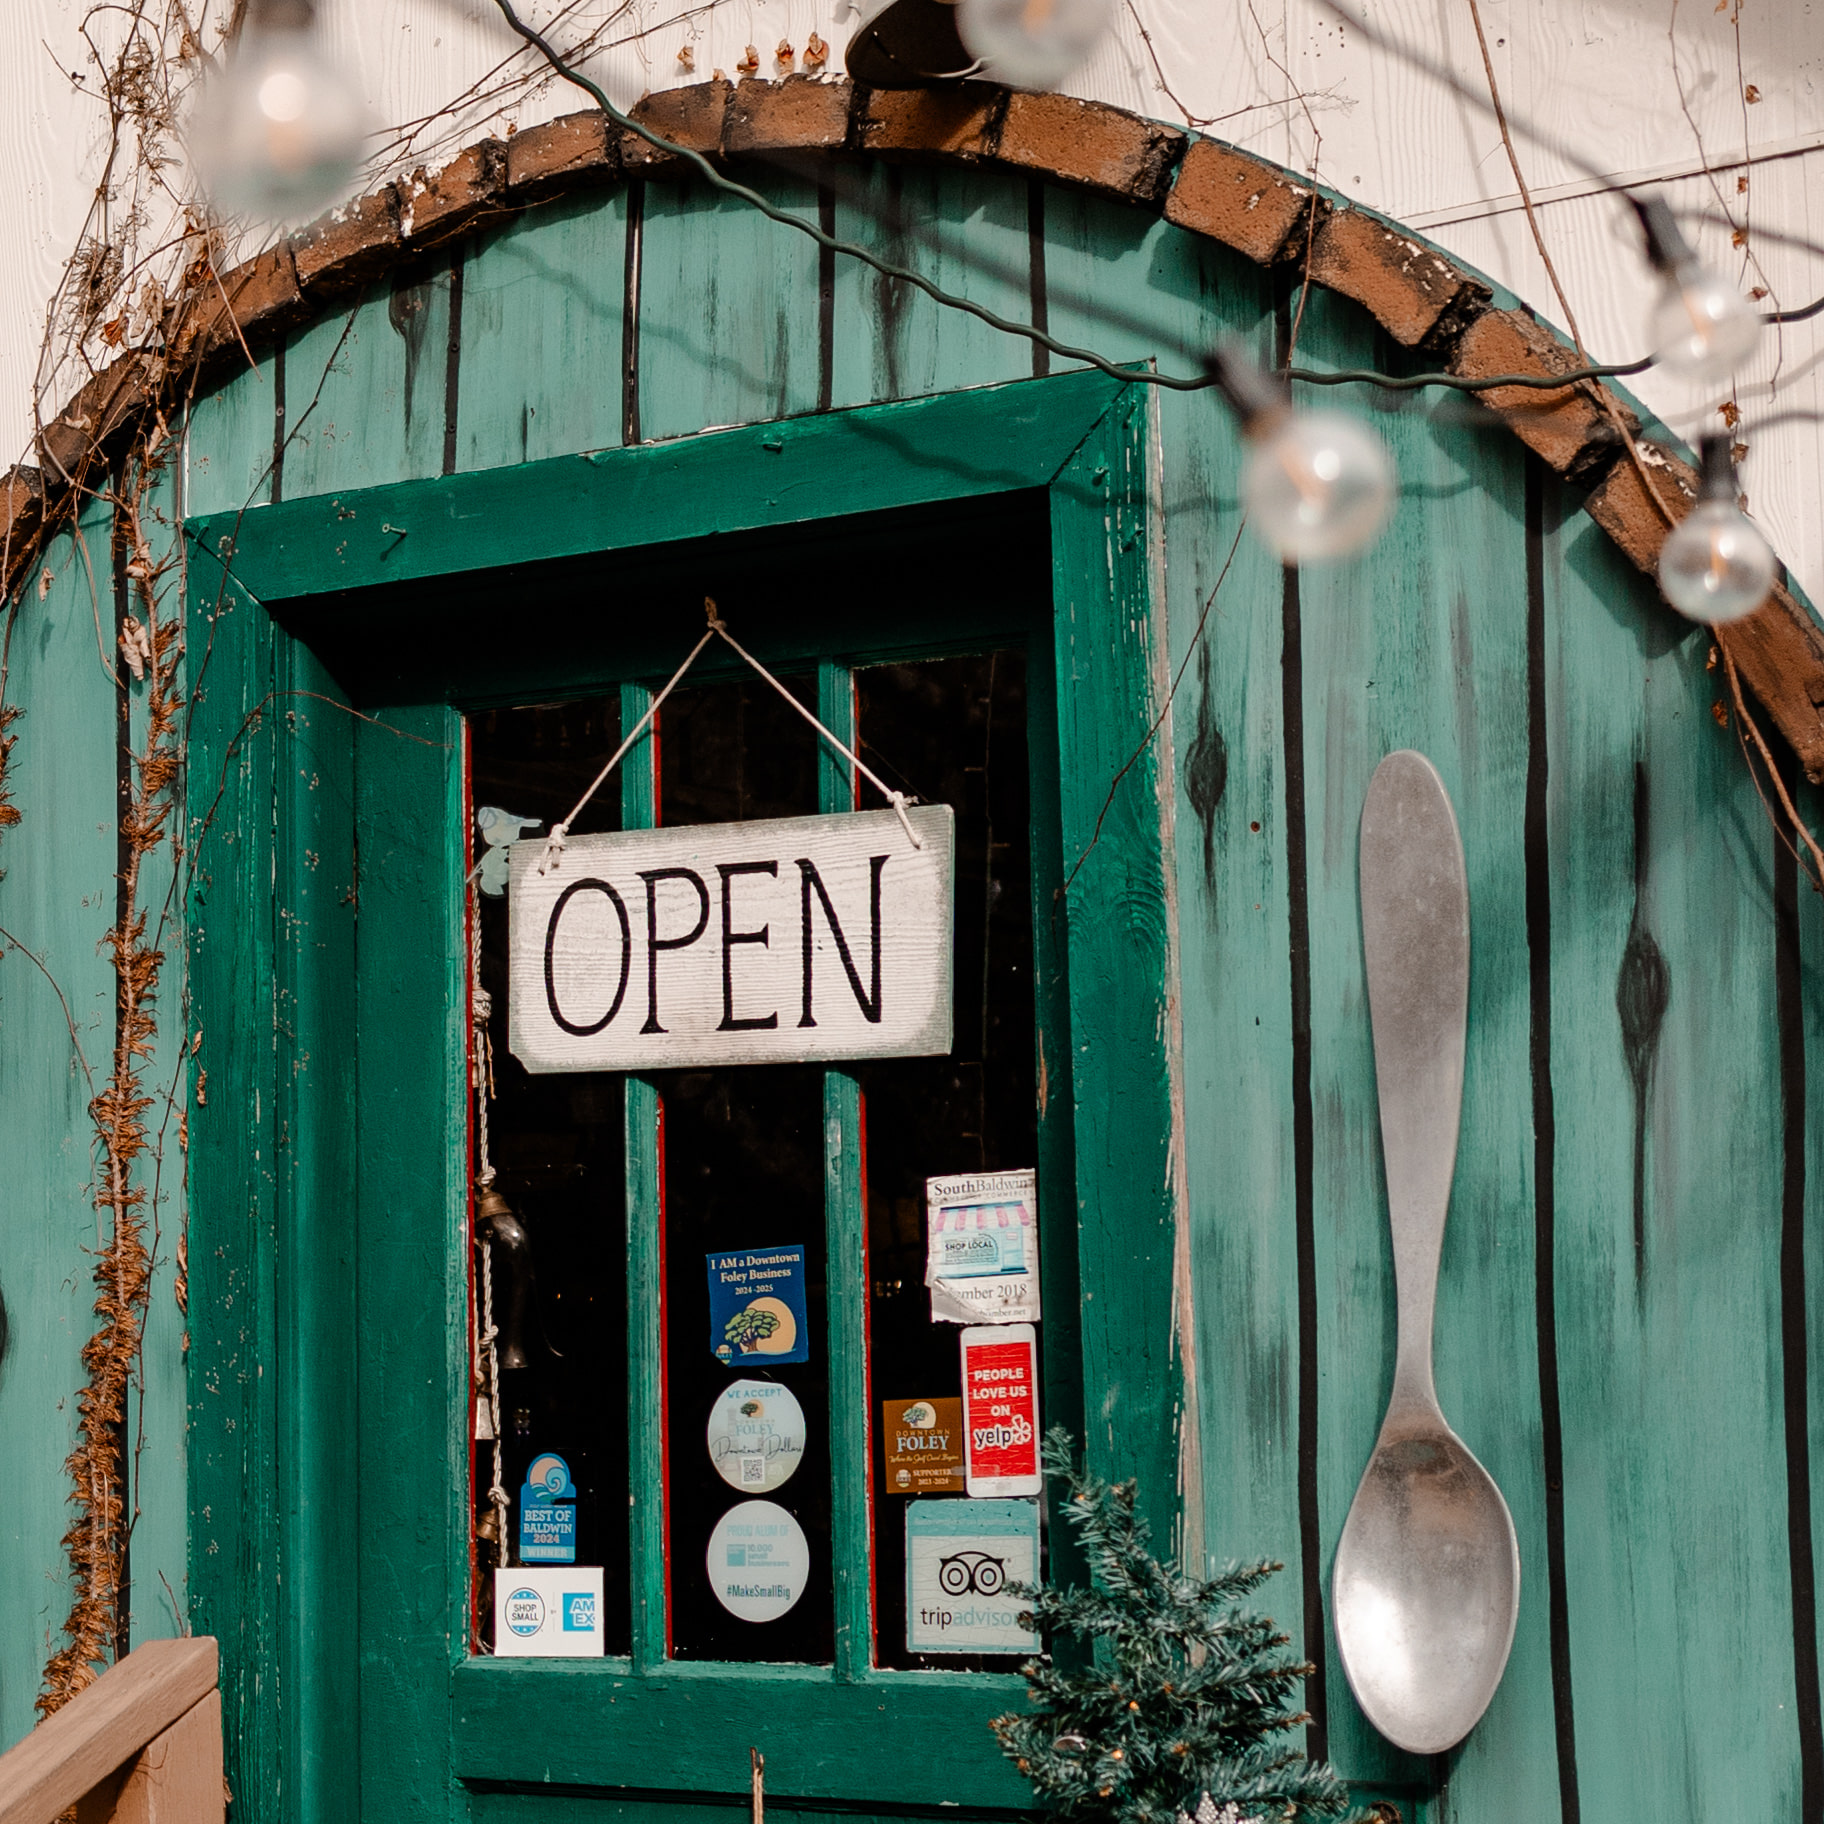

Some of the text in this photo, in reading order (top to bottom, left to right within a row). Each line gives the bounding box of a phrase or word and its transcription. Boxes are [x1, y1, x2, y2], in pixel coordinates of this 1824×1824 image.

[544, 855, 889, 1036] OPEN
[945, 1240, 993, 1251] SHOP LOCAL
[719, 1258, 737, 1269] AM
[739, 1259, 745, 1267] a
[746, 1254, 800, 1267] Downtown
[720, 1268, 792, 1283] Foley Business
[997, 1283, 1027, 1298] 2018
[974, 1368, 1024, 1381] PEOPLE
[728, 1388, 782, 1398] WE ACCEPT
[973, 1386, 1027, 1400] LOVE US
[991, 1405, 1010, 1416] ON
[897, 1435, 950, 1452] FOLEY
[975, 1427, 1011, 1447] yelp
[524, 1509, 572, 1522] BEST OF
[523, 1522, 572, 1534] BALDWIN
[533, 1533, 560, 1544] 2024
[727, 1584, 791, 1600] #MakeSmallBig
[513, 1604, 537, 1613] SHOP
[511, 1613, 539, 1622] SMALL
